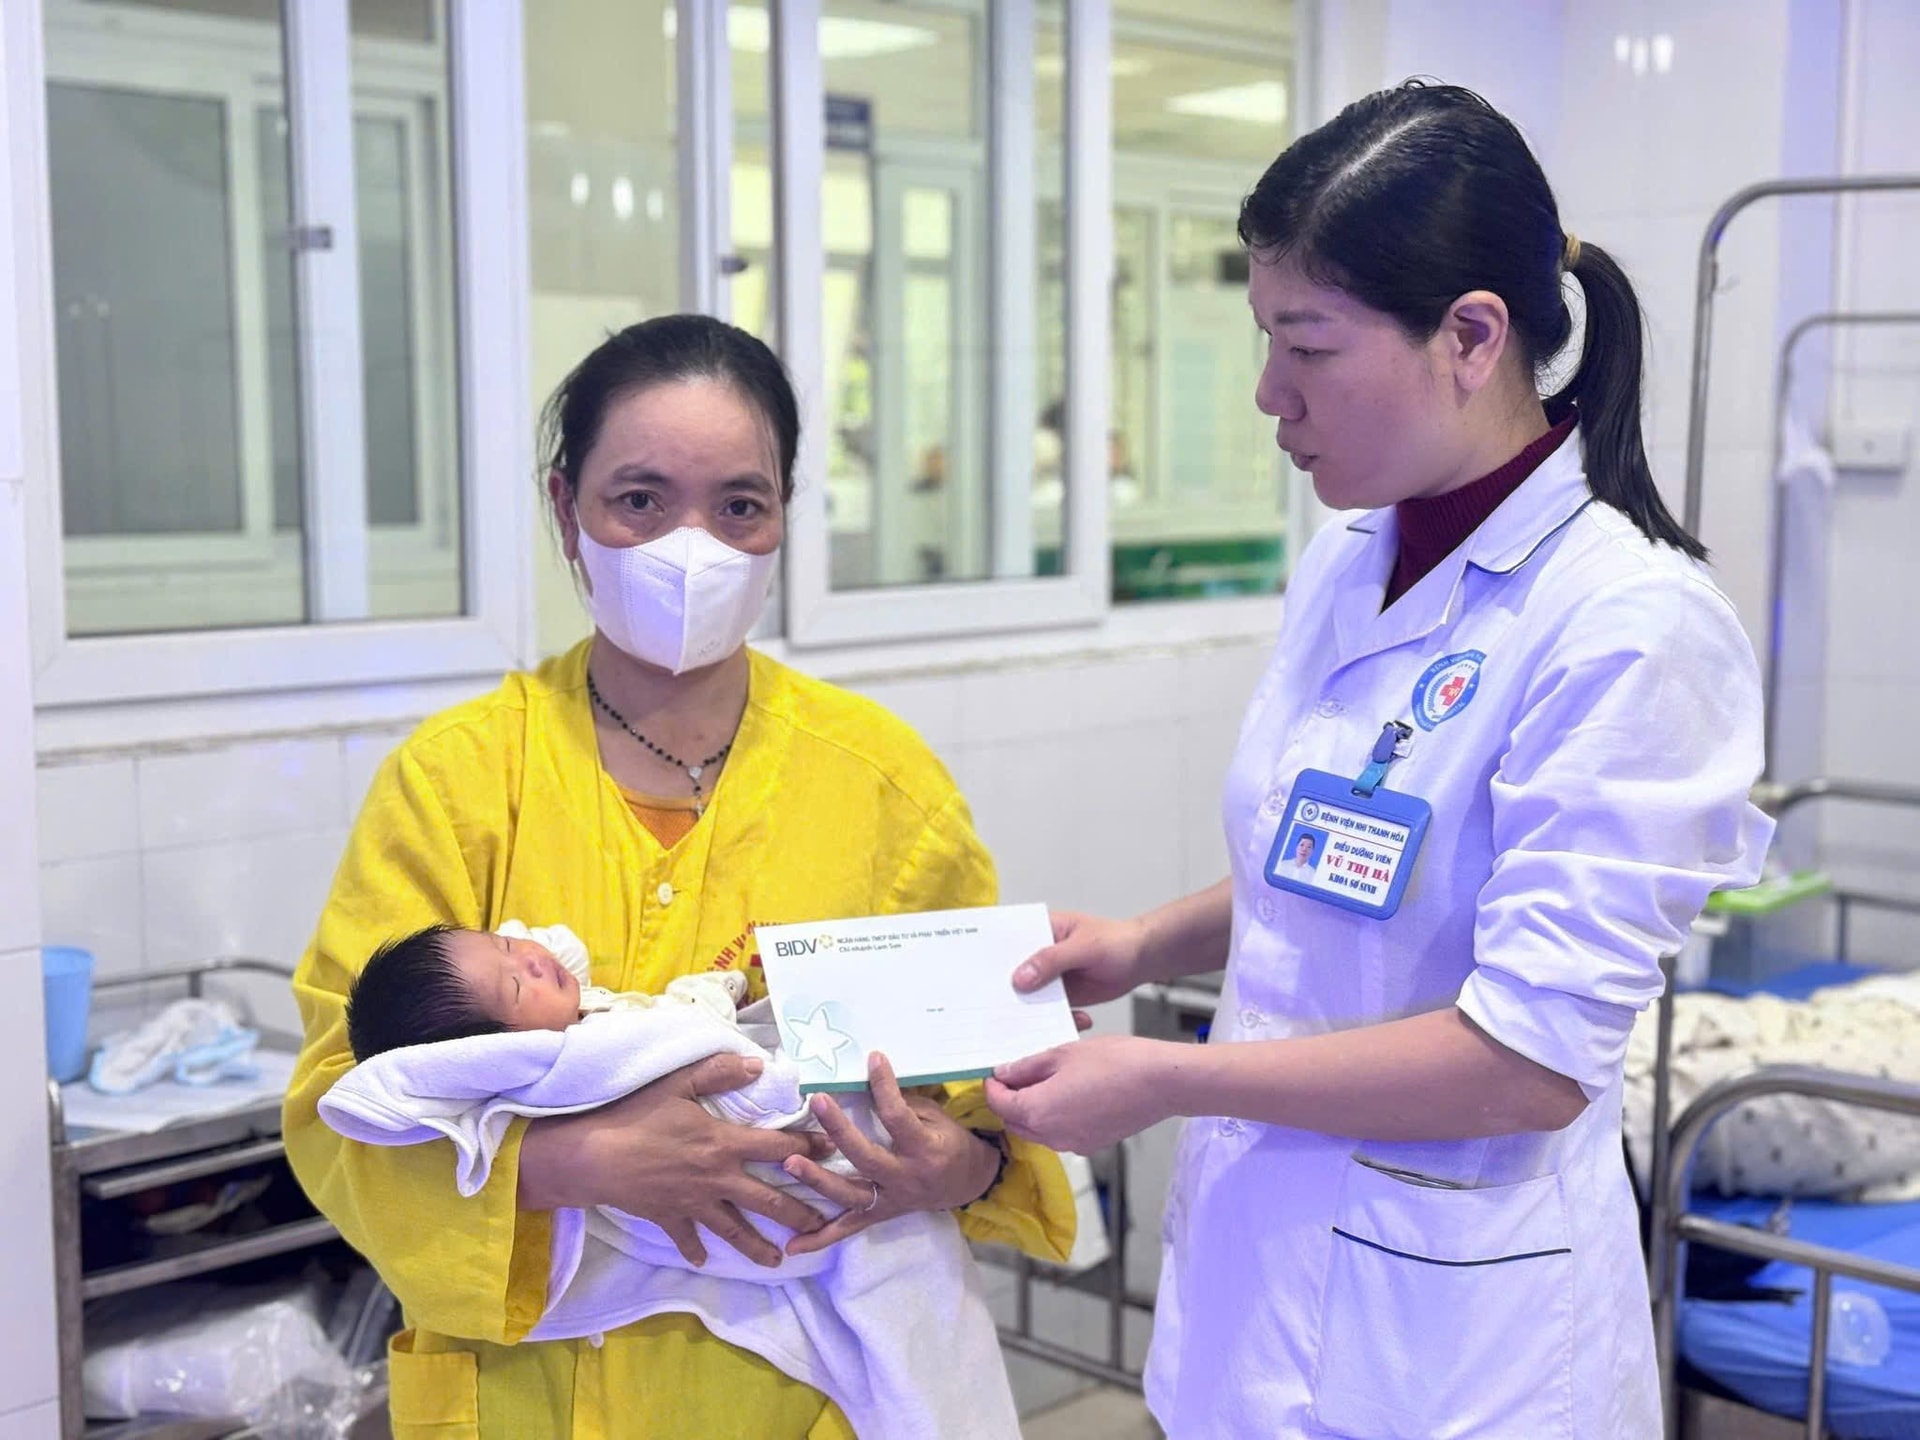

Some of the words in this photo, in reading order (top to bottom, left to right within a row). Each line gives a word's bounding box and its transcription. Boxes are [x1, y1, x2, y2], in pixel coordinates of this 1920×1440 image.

[1368, 825, 1390, 838] THANH
[1347, 860, 1369, 878] THỊ
[1328, 872, 1348, 886] KHOA
[775, 938, 817, 957] BIDV
